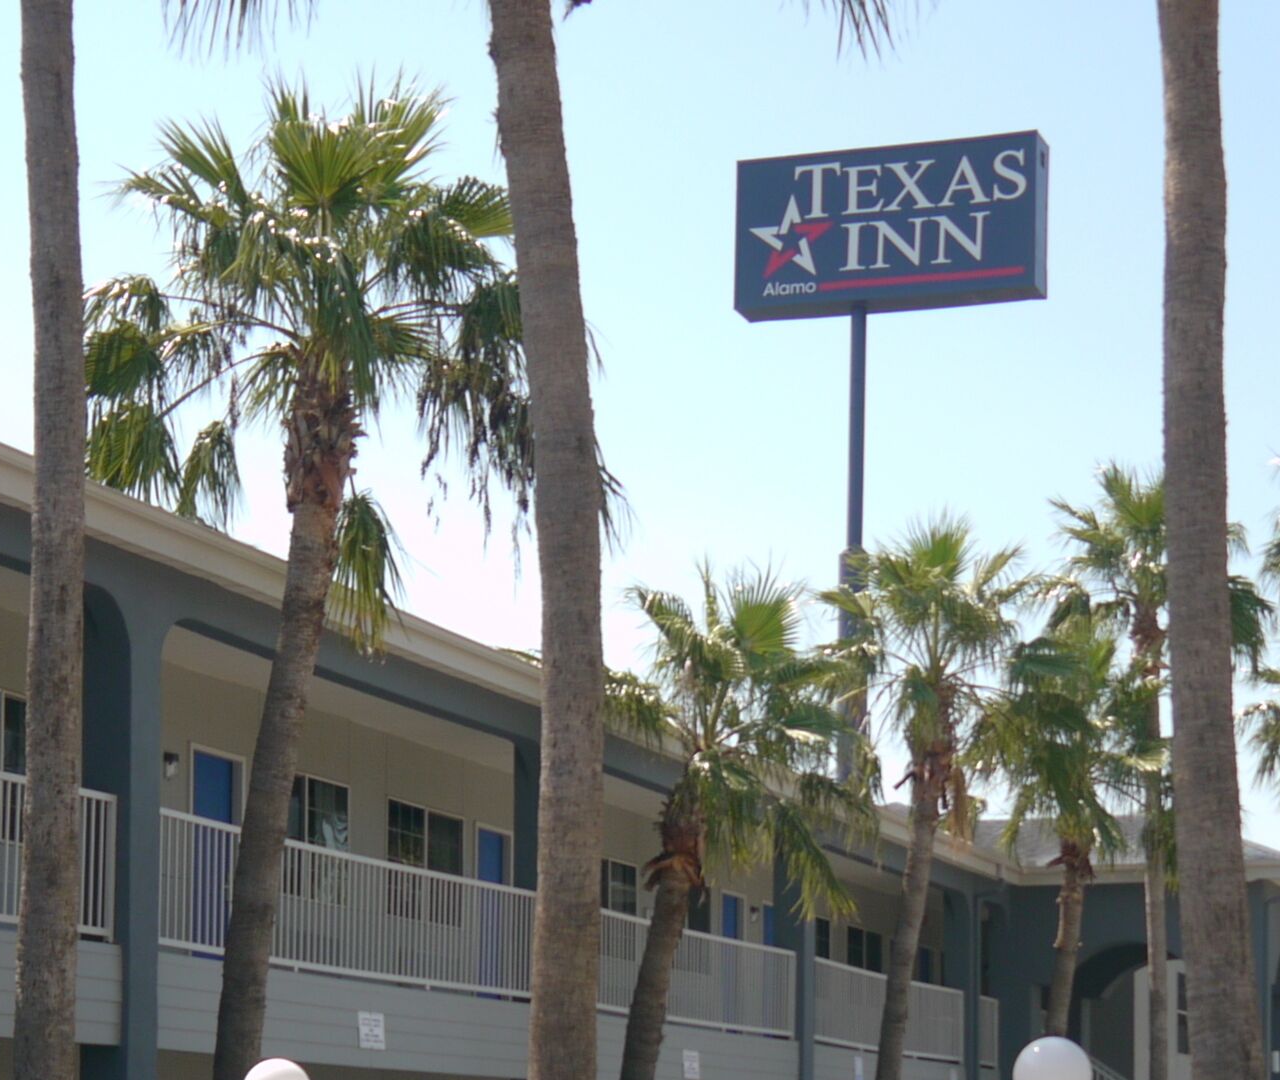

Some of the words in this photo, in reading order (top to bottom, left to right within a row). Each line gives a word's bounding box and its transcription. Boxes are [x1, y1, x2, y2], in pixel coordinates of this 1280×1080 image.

[794, 148, 1028, 219] TEXAS
[839, 211, 991, 272] INN
[762, 281, 817, 297] Alamo
